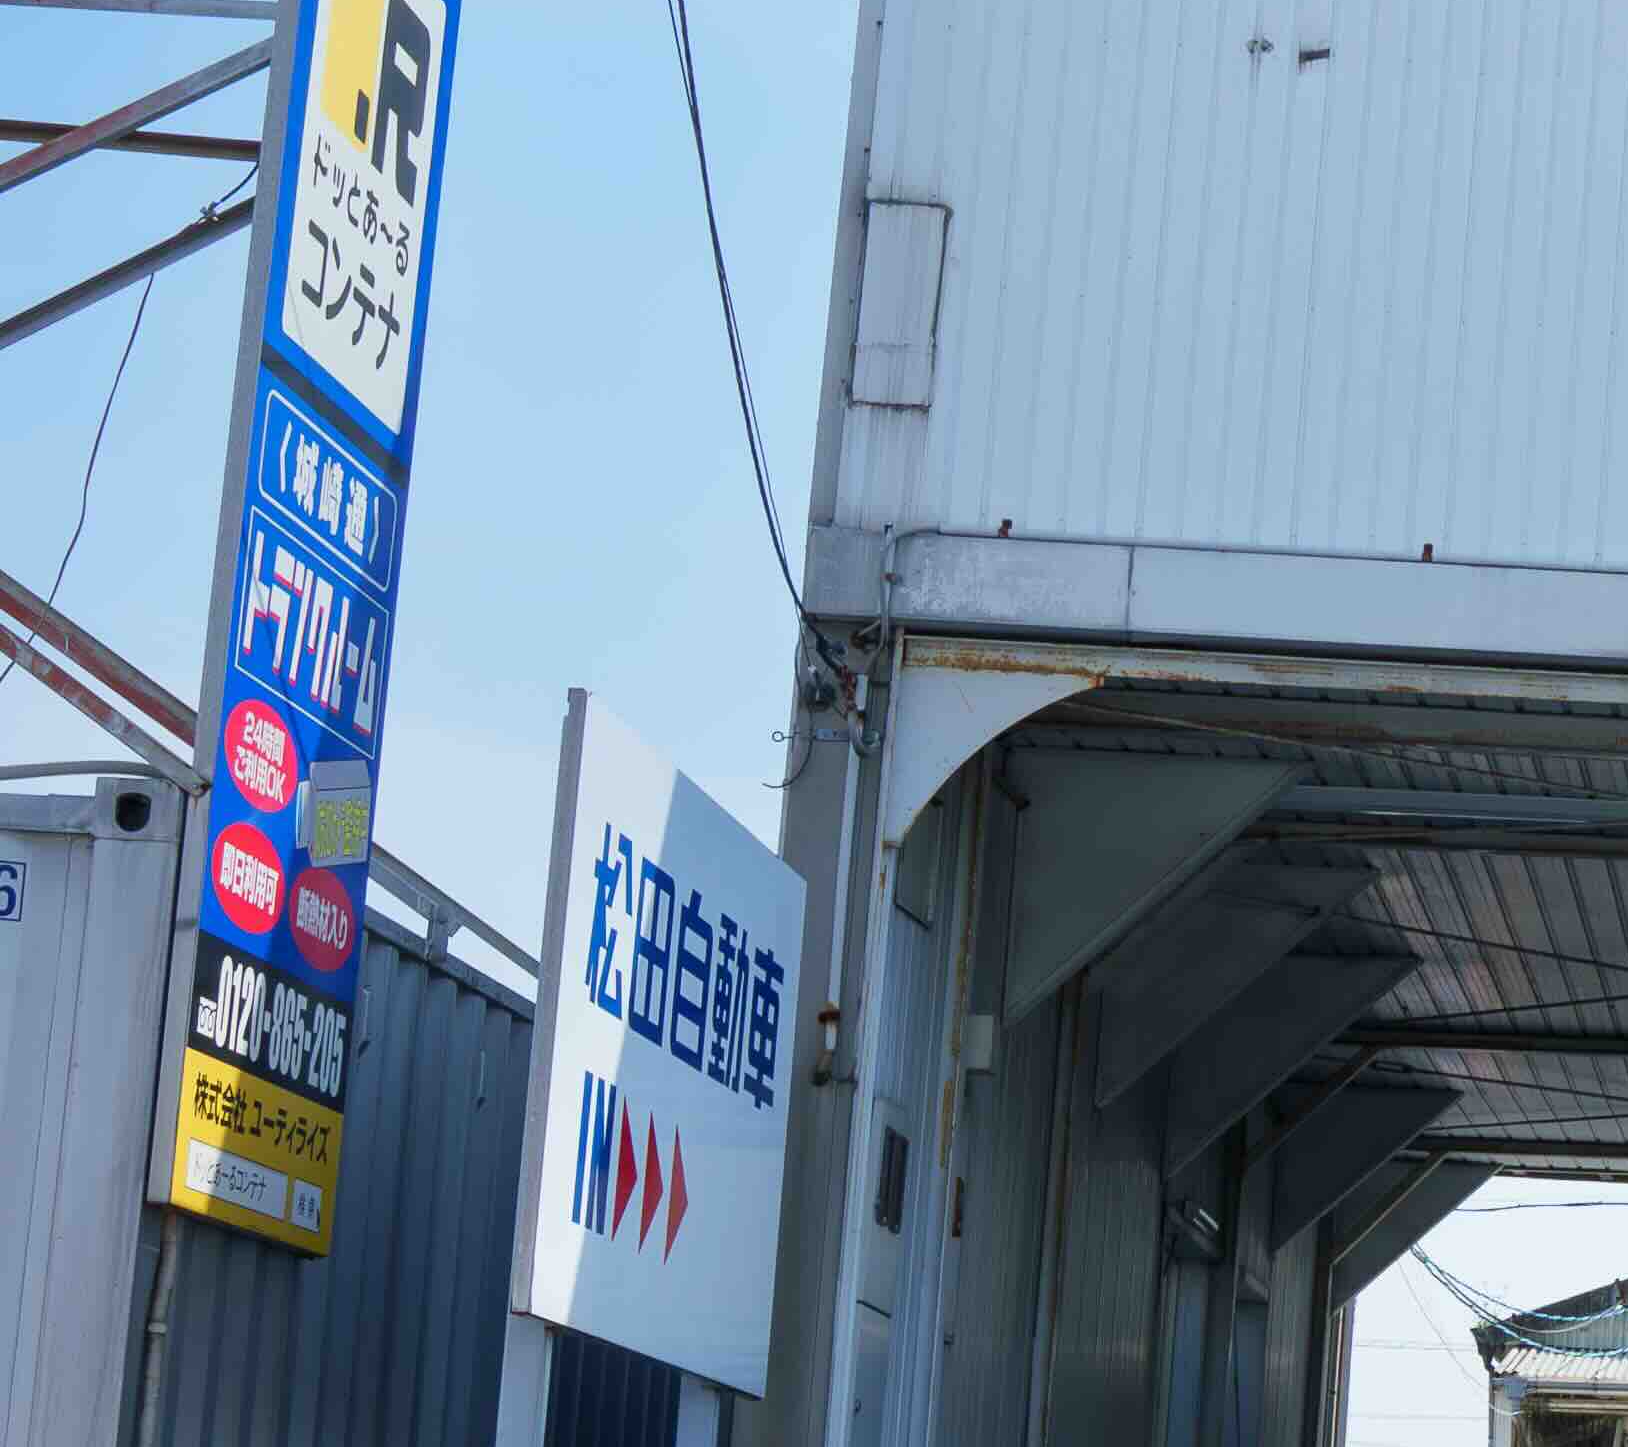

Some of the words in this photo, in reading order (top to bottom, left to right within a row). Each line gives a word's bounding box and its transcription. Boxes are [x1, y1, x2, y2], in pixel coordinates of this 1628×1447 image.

[302, 219, 400, 369] コンテナ
[243, 531, 376, 736] トランクルーム
[234, 745, 287, 804] ご利用OK
[242, 711, 286, 767] 24時間
[219, 841, 279, 916] 即日利用可
[296, 886, 348, 950] 断熱材入り
[585, 822, 784, 1110] 松田自動車
[214, 955, 347, 1097] 0120-865-205
[194, 1071, 248, 1134] 株式会社
[571, 1070, 617, 1235] IN
